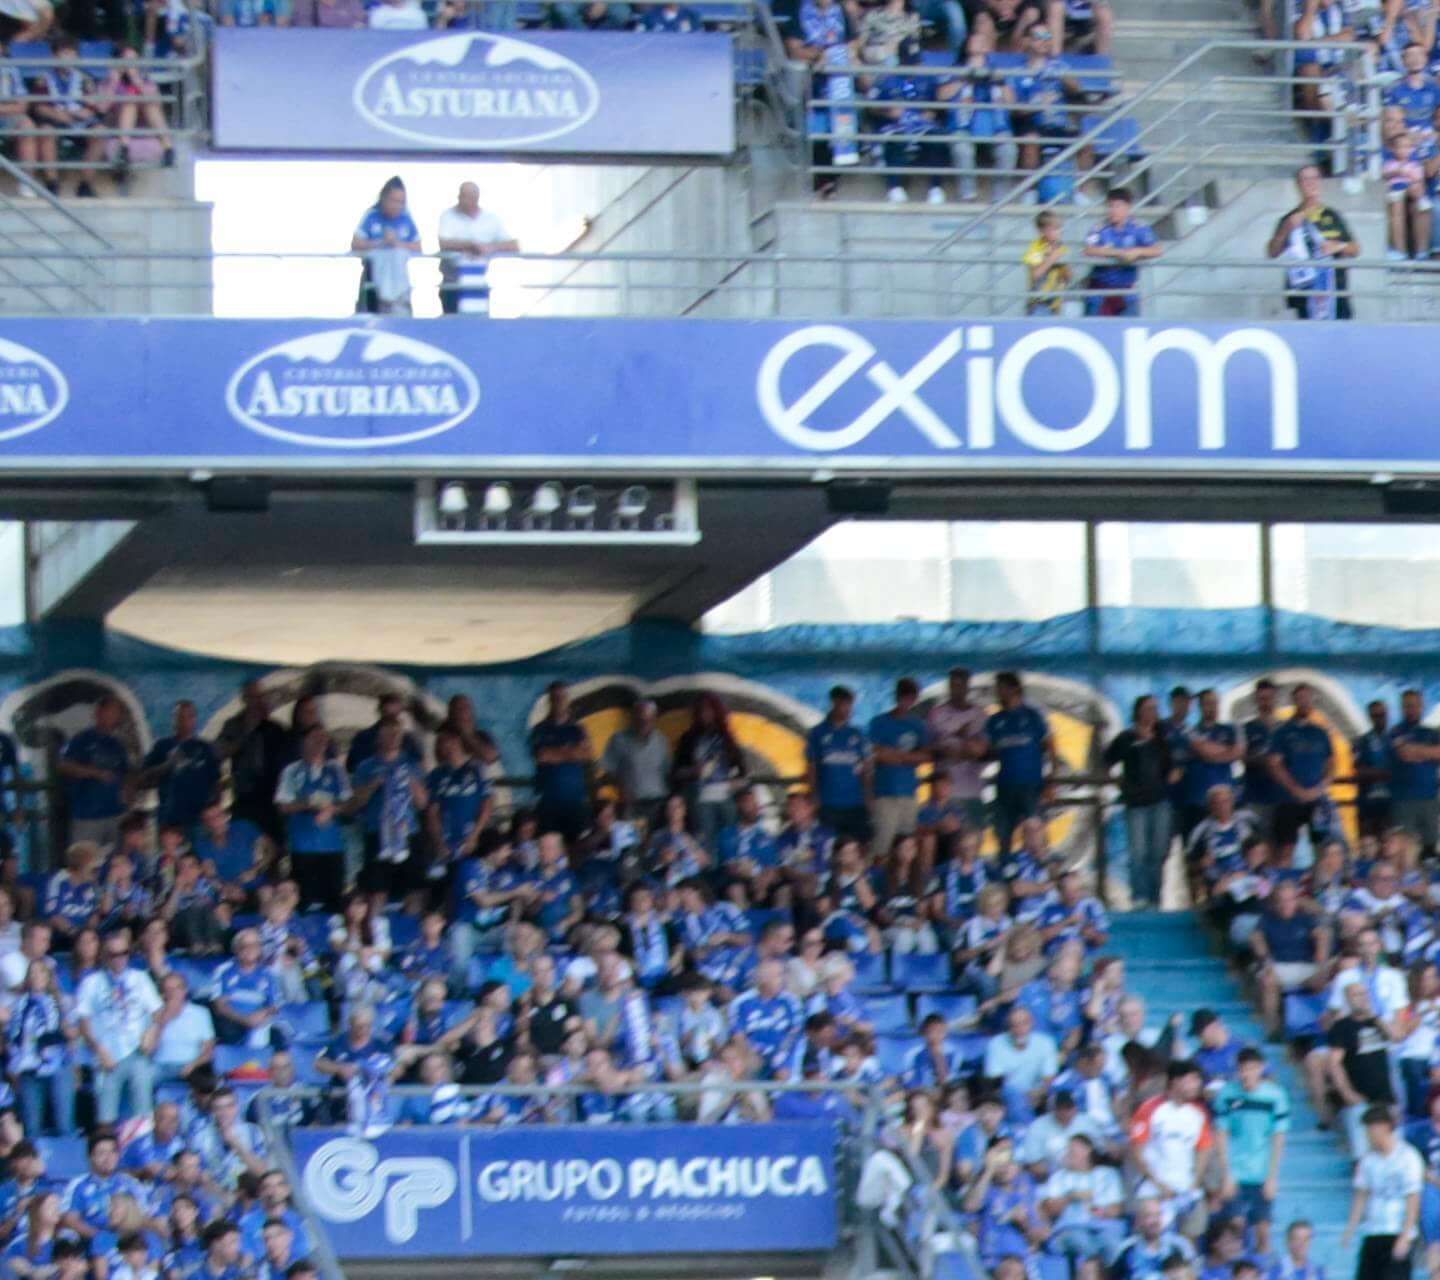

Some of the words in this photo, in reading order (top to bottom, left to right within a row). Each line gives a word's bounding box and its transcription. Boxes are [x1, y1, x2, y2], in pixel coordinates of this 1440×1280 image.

[376, 73, 579, 118] ASTURIANA
[248, 371, 461, 417] ASTURIANA
[757, 325, 1299, 452] exiom
[477, 1159, 621, 1201] GRUPO
[629, 1155, 828, 1198] PACHUCA
